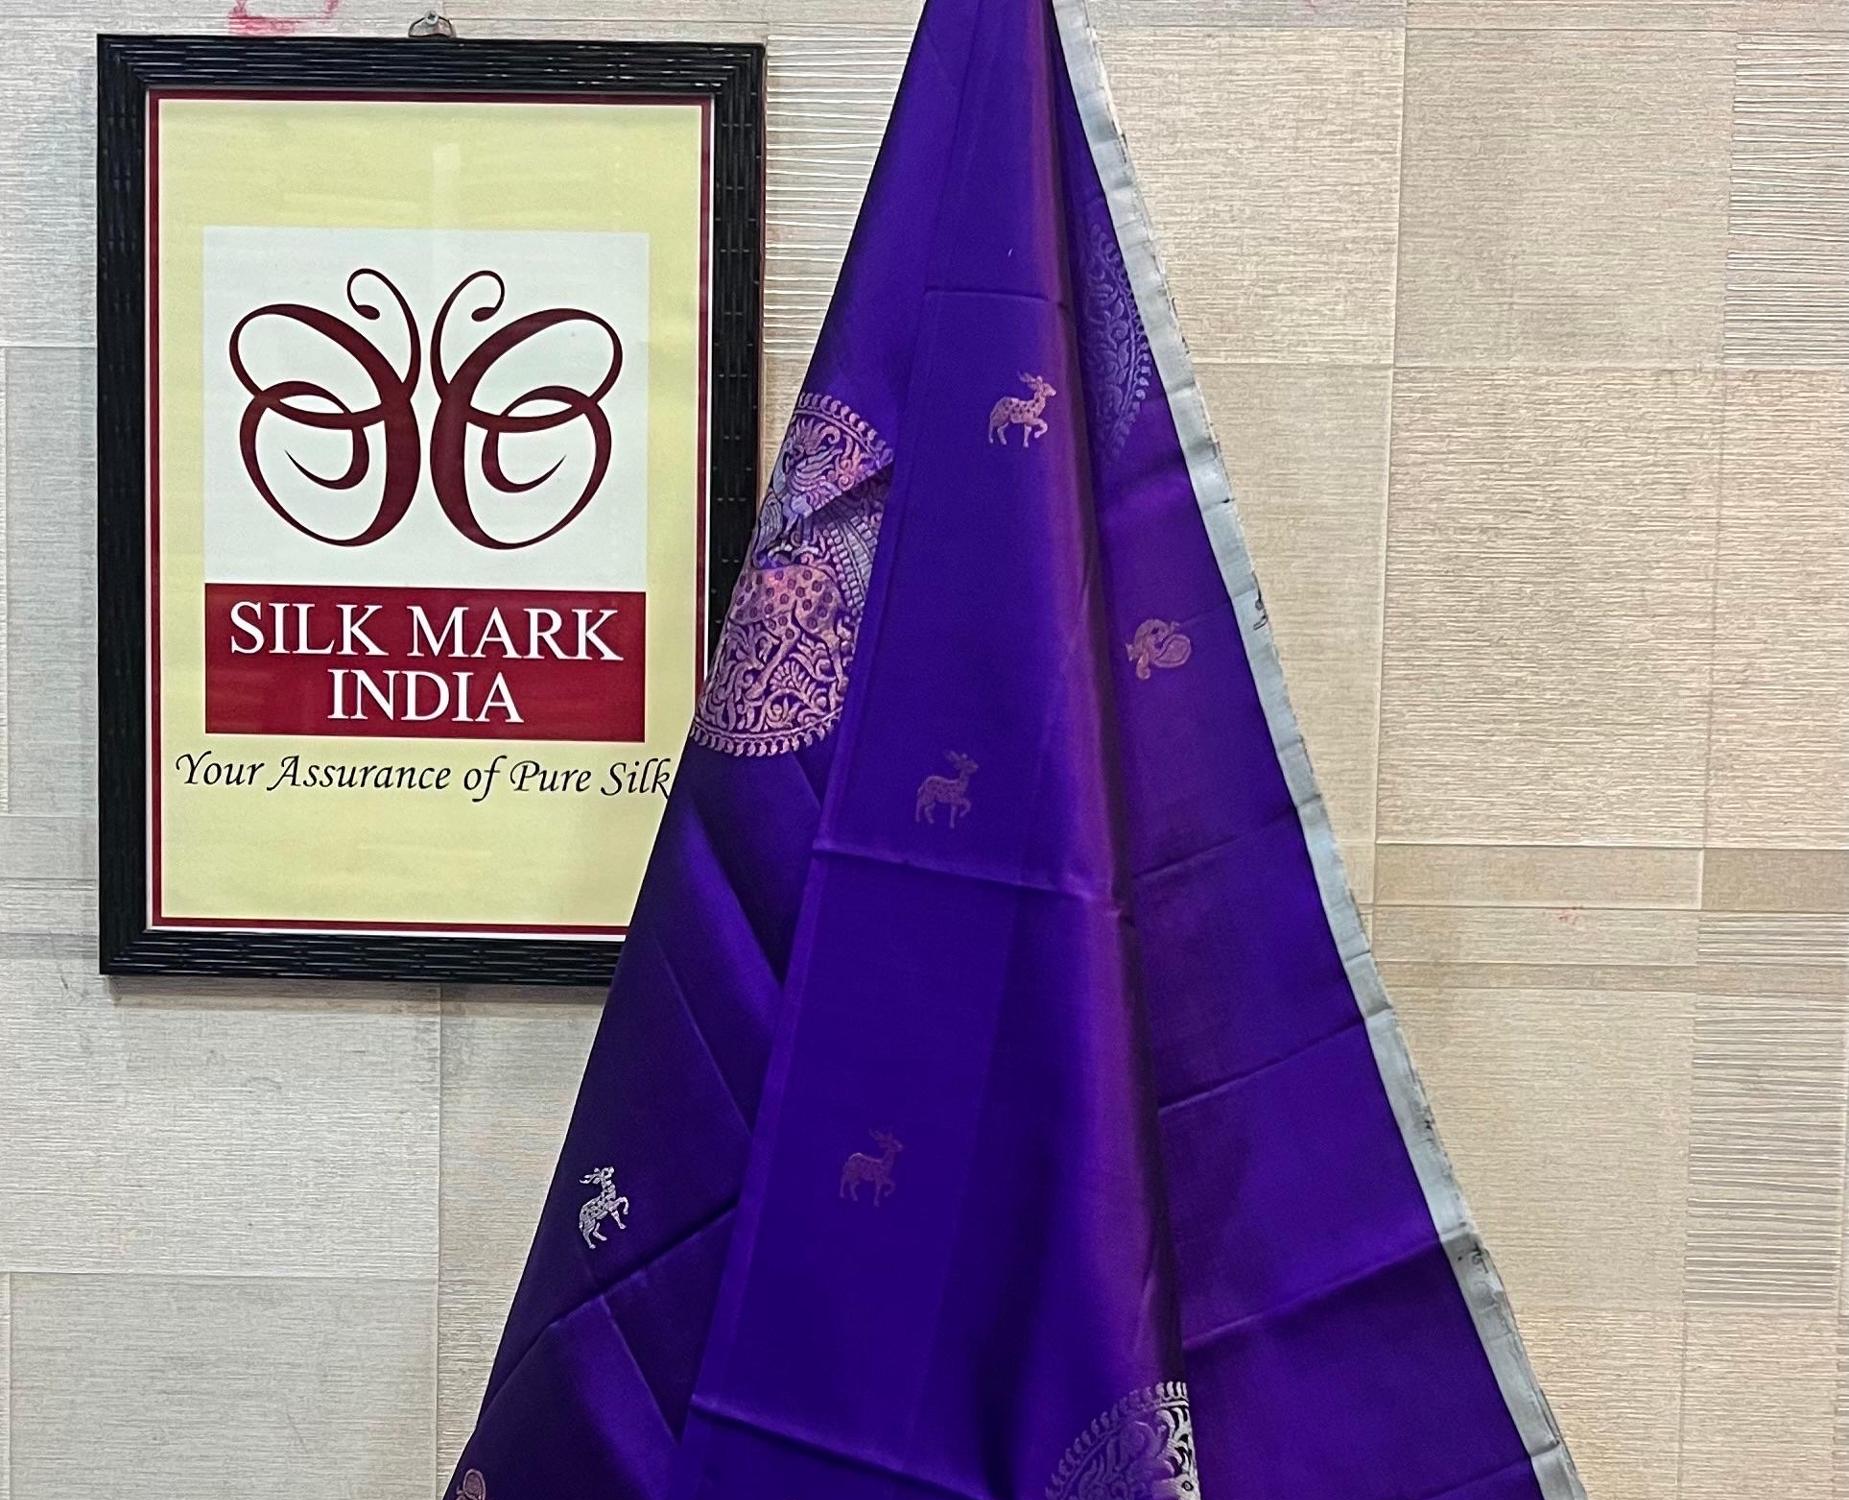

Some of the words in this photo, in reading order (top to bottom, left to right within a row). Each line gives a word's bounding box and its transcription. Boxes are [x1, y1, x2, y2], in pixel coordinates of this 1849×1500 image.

[231, 601, 388, 655] SILK
[406, 606, 623, 661] MARK
[327, 668, 525, 724] INDIA
[175, 750, 264, 786] Your
[267, 755, 451, 791] Assurance
[463, 755, 507, 802] of
[510, 760, 591, 792] Pure
[600, 758, 671, 799] Silk
